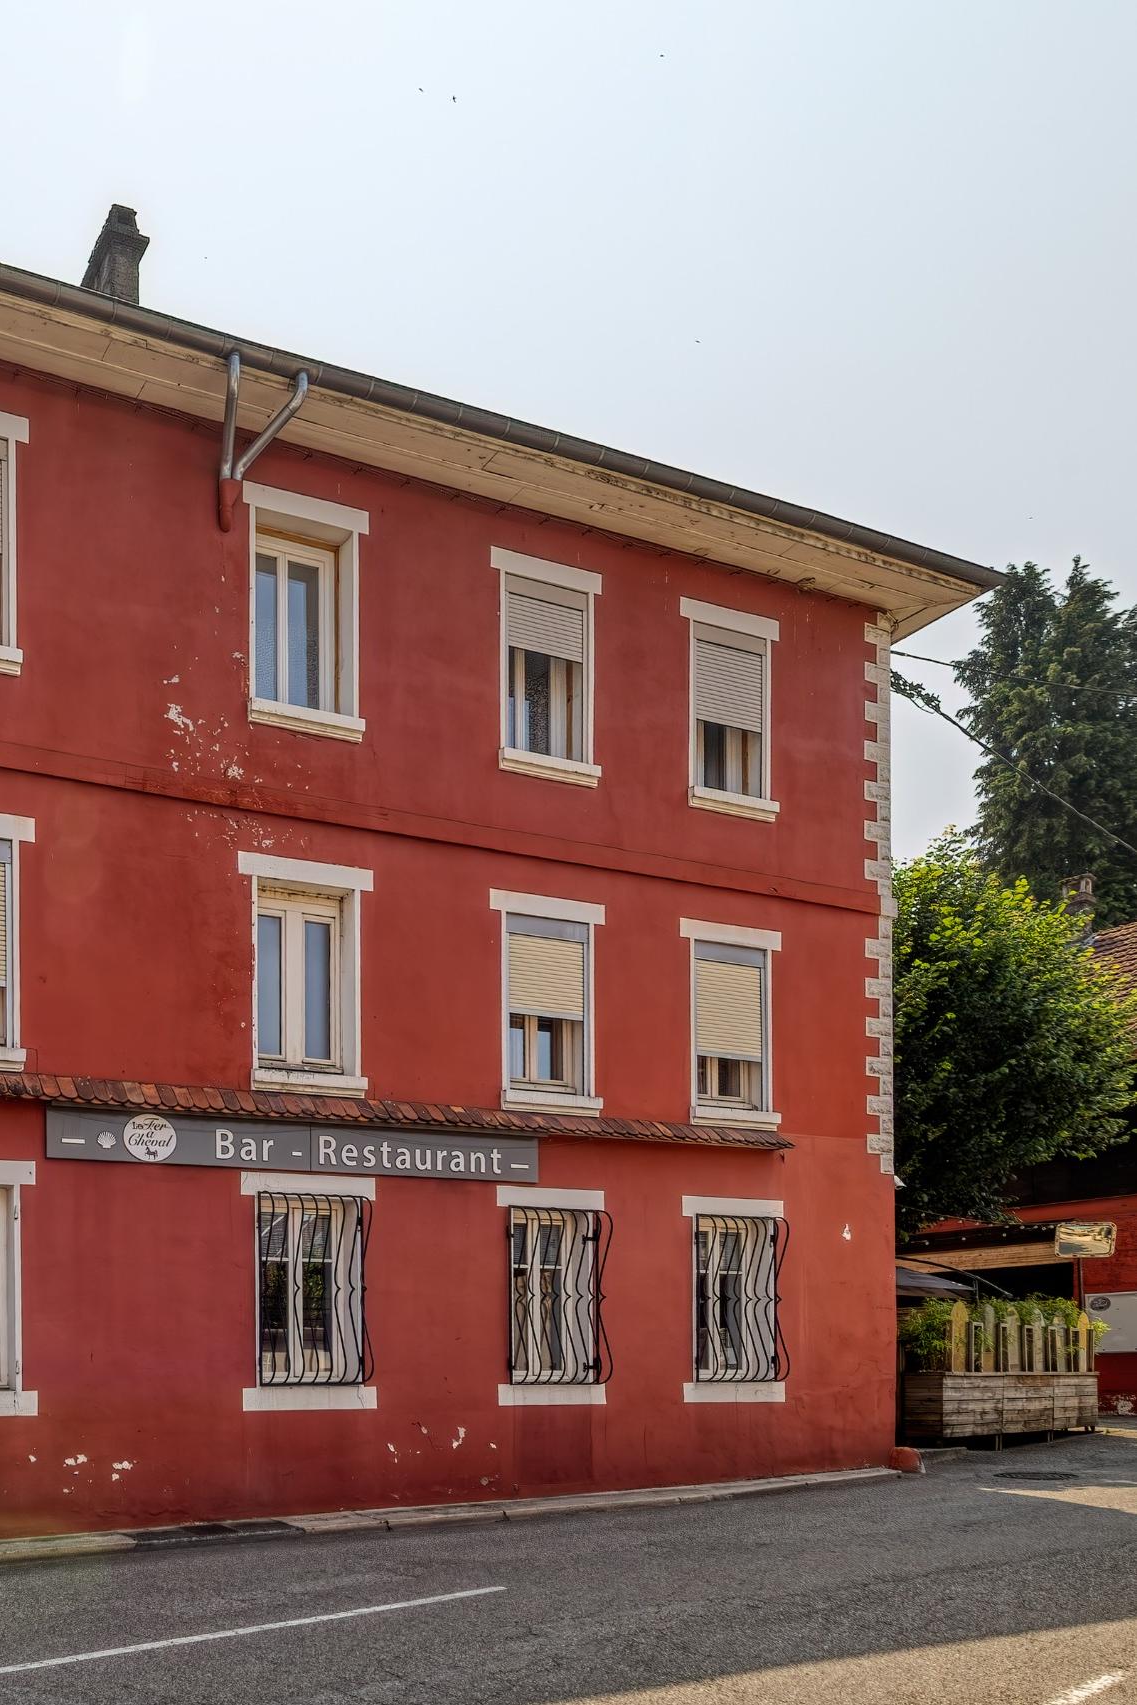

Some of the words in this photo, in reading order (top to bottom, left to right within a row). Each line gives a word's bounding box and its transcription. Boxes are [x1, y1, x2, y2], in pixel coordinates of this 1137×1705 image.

[143, 1117, 171, 1131] Fer
[128, 1133, 174, 1147] Cheval
[214, 1128, 275, 1163] Bar
[318, 1134, 503, 1175] Restaurant
